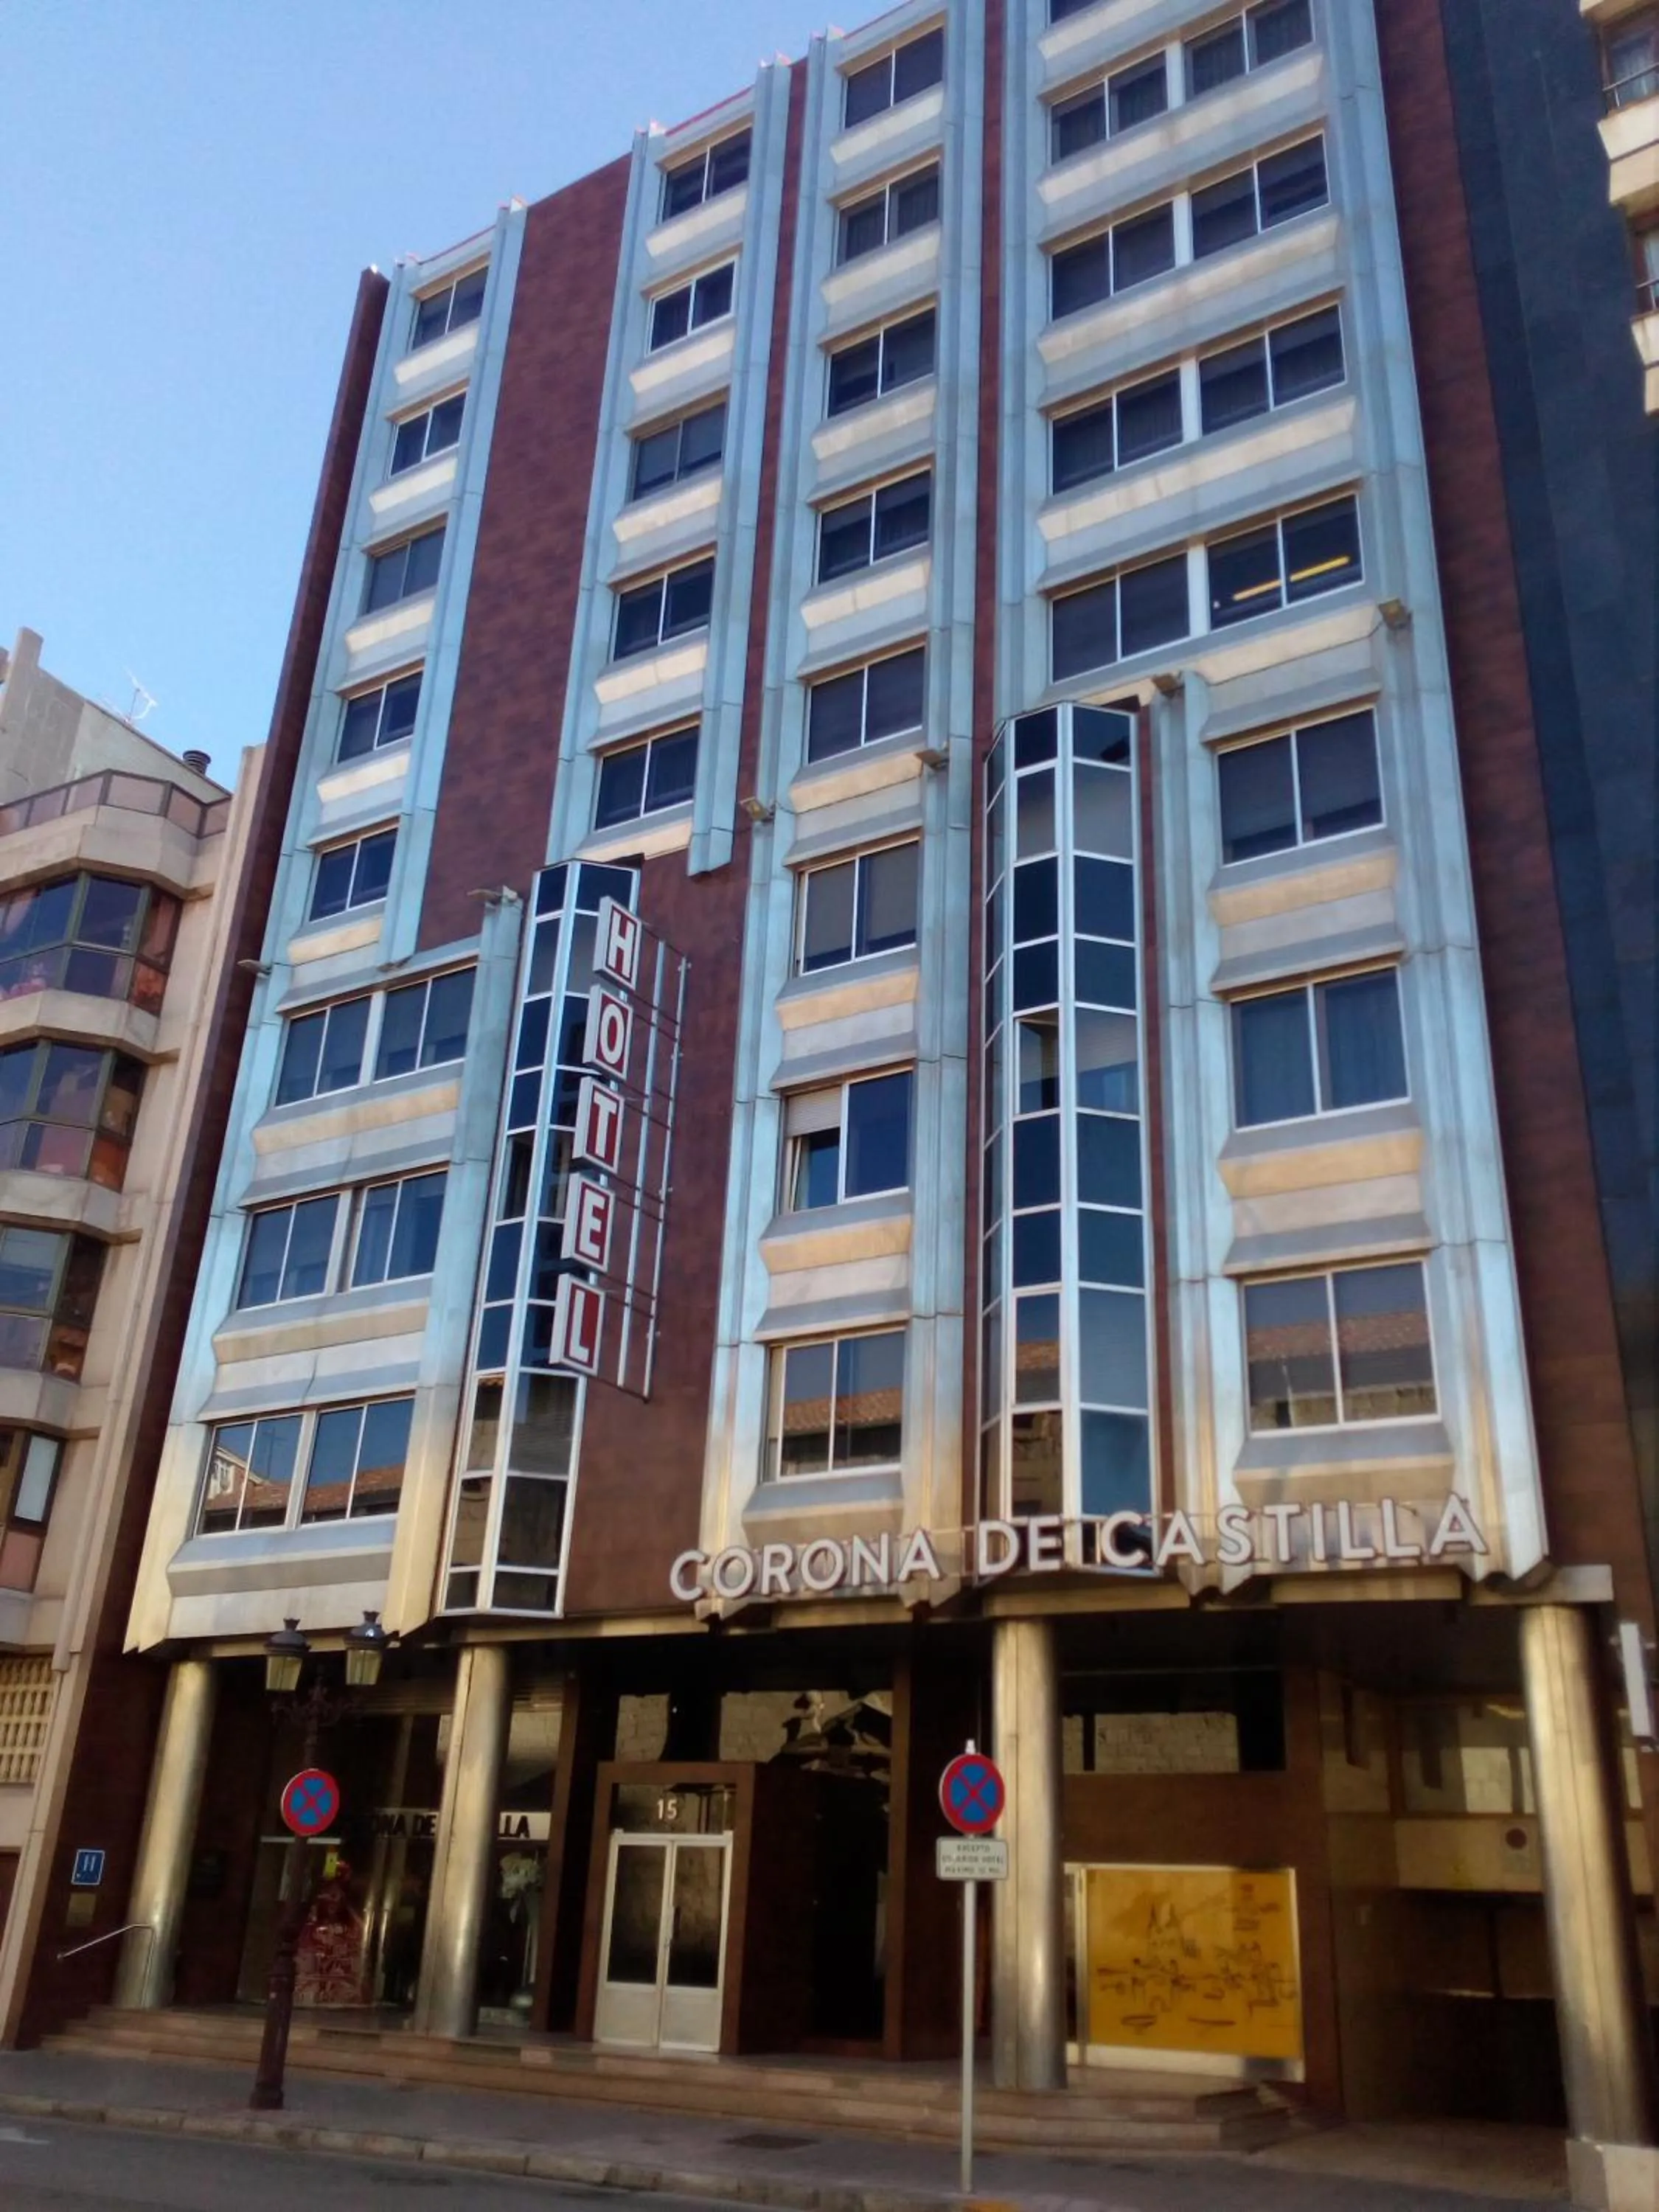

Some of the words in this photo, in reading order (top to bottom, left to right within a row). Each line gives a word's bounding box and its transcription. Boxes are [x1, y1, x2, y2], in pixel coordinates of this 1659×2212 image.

[568, 908, 636, 1364] HOTEL
[669, 1528, 941, 1601] CORONA
[978, 1514, 1062, 1576] DE
[1101, 1493, 1488, 1568] CASTILLA
[412, 1815, 437, 1836] DE
[657, 1798, 677, 1820] 15
